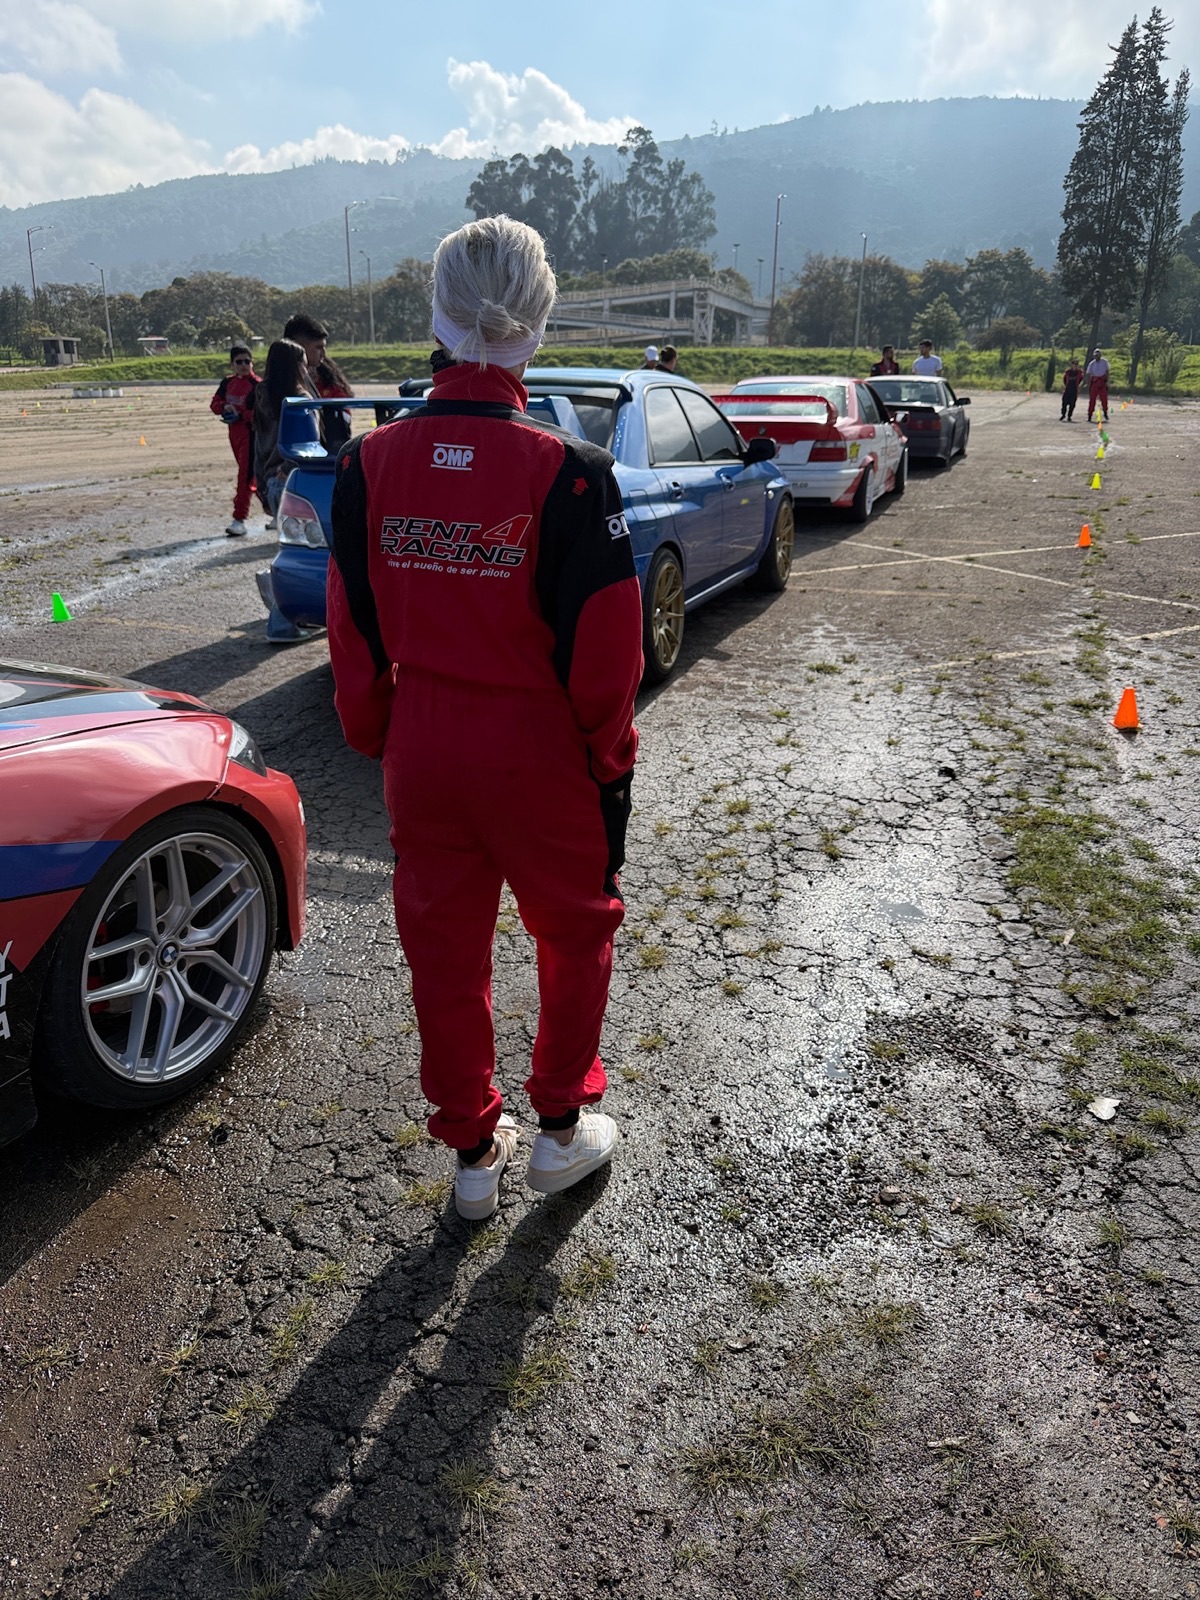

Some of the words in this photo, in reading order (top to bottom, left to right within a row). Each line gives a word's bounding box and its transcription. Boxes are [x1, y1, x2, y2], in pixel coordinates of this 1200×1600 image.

[433, 446, 474, 467] OMP
[382, 516, 482, 543] RENT
[482, 514, 534, 548] 4
[380, 536, 527, 567] RACING
[401, 559, 411, 569] el
[413, 560, 443, 573] sueño
[446, 564, 458, 574] de
[460, 567, 478, 576] ser
[479, 568, 511, 579] piloto
